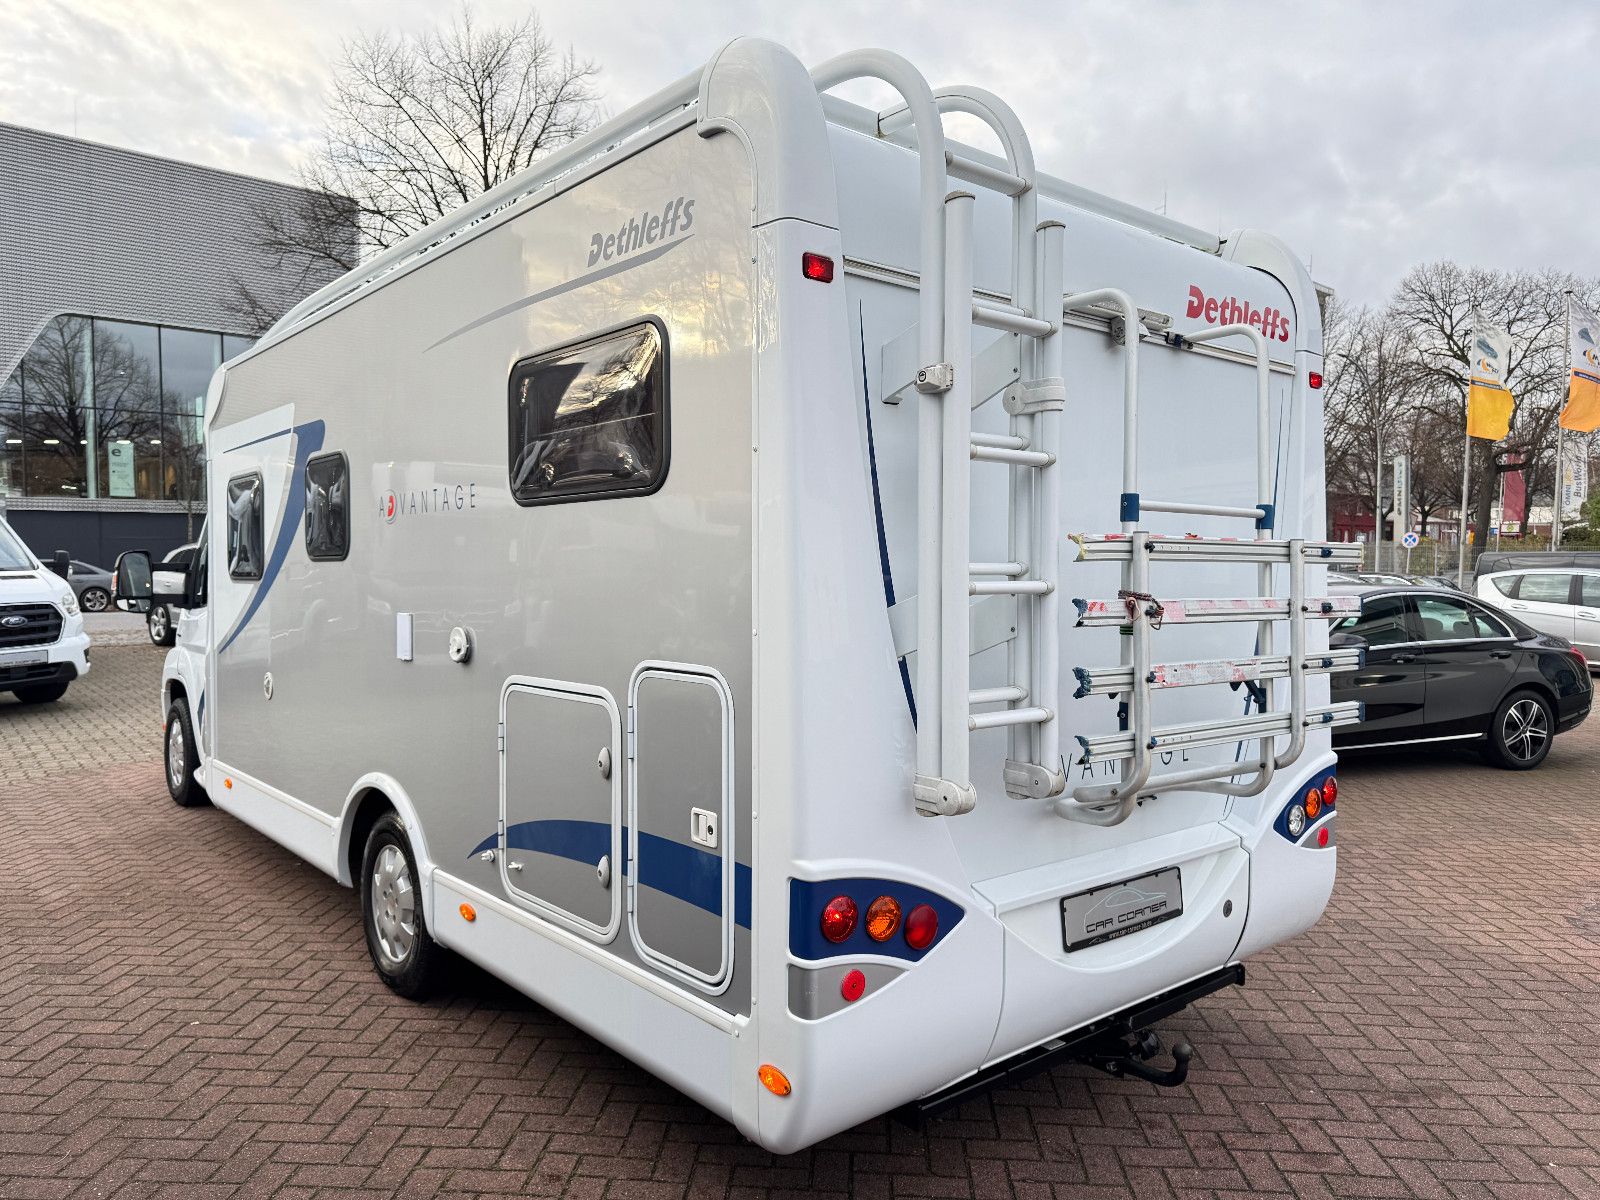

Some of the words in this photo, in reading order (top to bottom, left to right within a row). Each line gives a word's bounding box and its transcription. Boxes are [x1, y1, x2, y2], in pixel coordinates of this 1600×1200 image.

[587, 196, 695, 267] Dethleffs
[1186, 284, 1290, 342] Dethleffs
[378, 483, 476, 524] ADVANTAGE
[1086, 917, 1114, 933] CAR
[1117, 900, 1167, 923] CORNER
